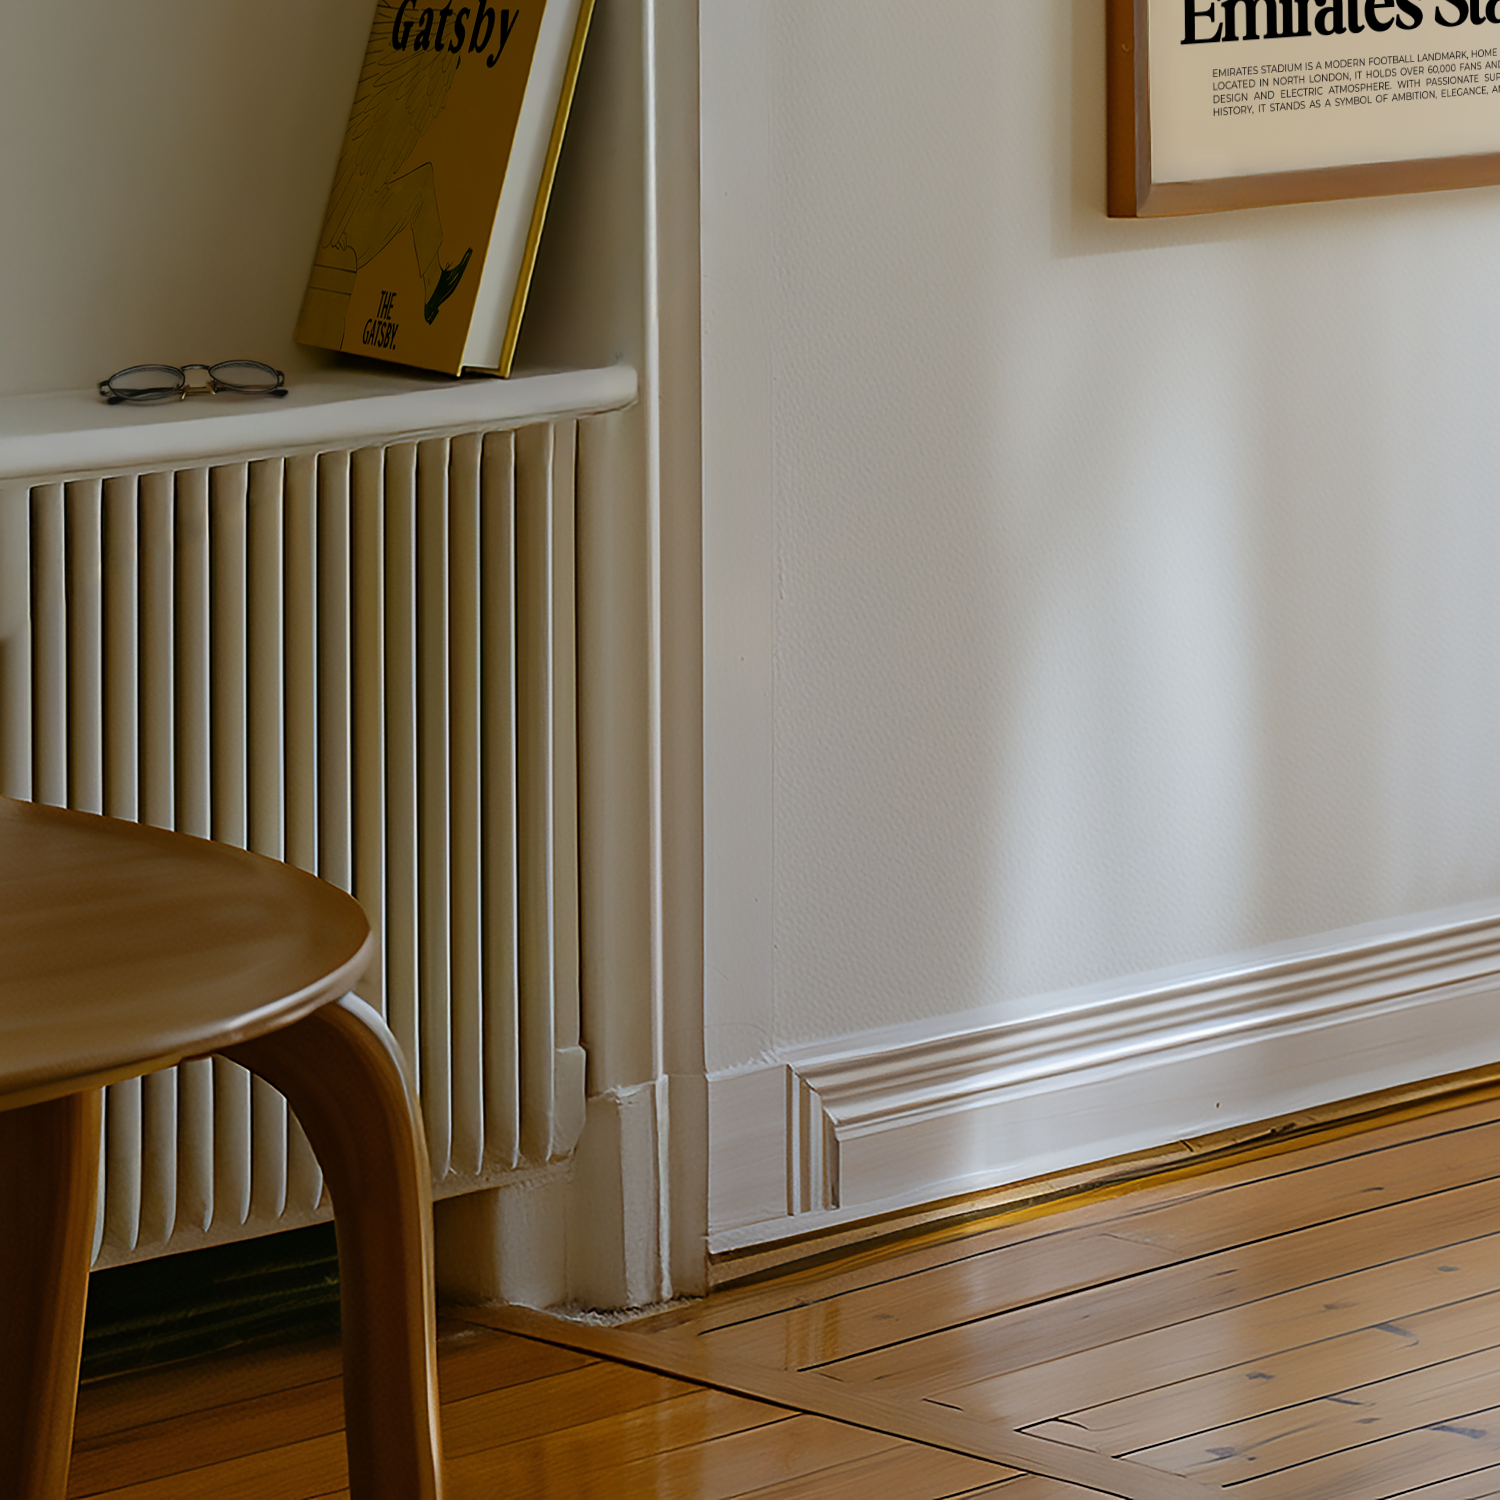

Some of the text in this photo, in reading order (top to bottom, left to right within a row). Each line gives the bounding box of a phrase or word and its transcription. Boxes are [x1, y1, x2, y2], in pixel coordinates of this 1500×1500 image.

[1212, 66, 1259, 78] EMIRATES
[1260, 63, 1303, 75] STADIUM
[1304, 62, 1314, 71] IS
[1315, 61, 1323, 70] A
[1324, 58, 1366, 70] MODERN
[1368, 55, 1415, 66] FOOTBALL
[1417, 51, 1469, 63] LANDMARK,
[1470, 48, 1498, 59] HOME
[1212, 79, 1256, 92] LOCATED
[1259, 78, 1269, 88] IN
[1272, 76, 1306, 86] NORTH
[1308, 72, 1352, 84] LONDON,
[1354, 71, 1363, 80] IT
[1365, 68, 1398, 79] HOLDS
[1399, 66, 1425, 77] OVER
[1427, 64, 1457, 75] 60,000
[1459, 61, 1482, 72] FANS
[1212, 93, 1249, 105] DESIGN
[1253, 91, 1276, 101] AND
[1280, 87, 1324, 99] ELECTRIC
[1327, 81, 1392, 95] ATMOSPHERE.
[1396, 79, 1421, 89] WITH
[1425, 74, 1480, 87] PASSIONATE
[1212, 105, 1255, 117] HISTORY,
[1258, 104, 1267, 113] IT
[1269, 101, 1306, 113] STANDS
[1308, 99, 1322, 109] AS
[1324, 99, 1332, 108] A
[1334, 96, 1373, 107] SYMBOL
[1375, 94, 1389, 104] OF
[1391, 90, 1438, 102] AMBITION,
[1440, 86, 1489, 98] ELEGANCE,
[376, 290, 397, 320] THE
[362, 318, 399, 350] GATSBY.
